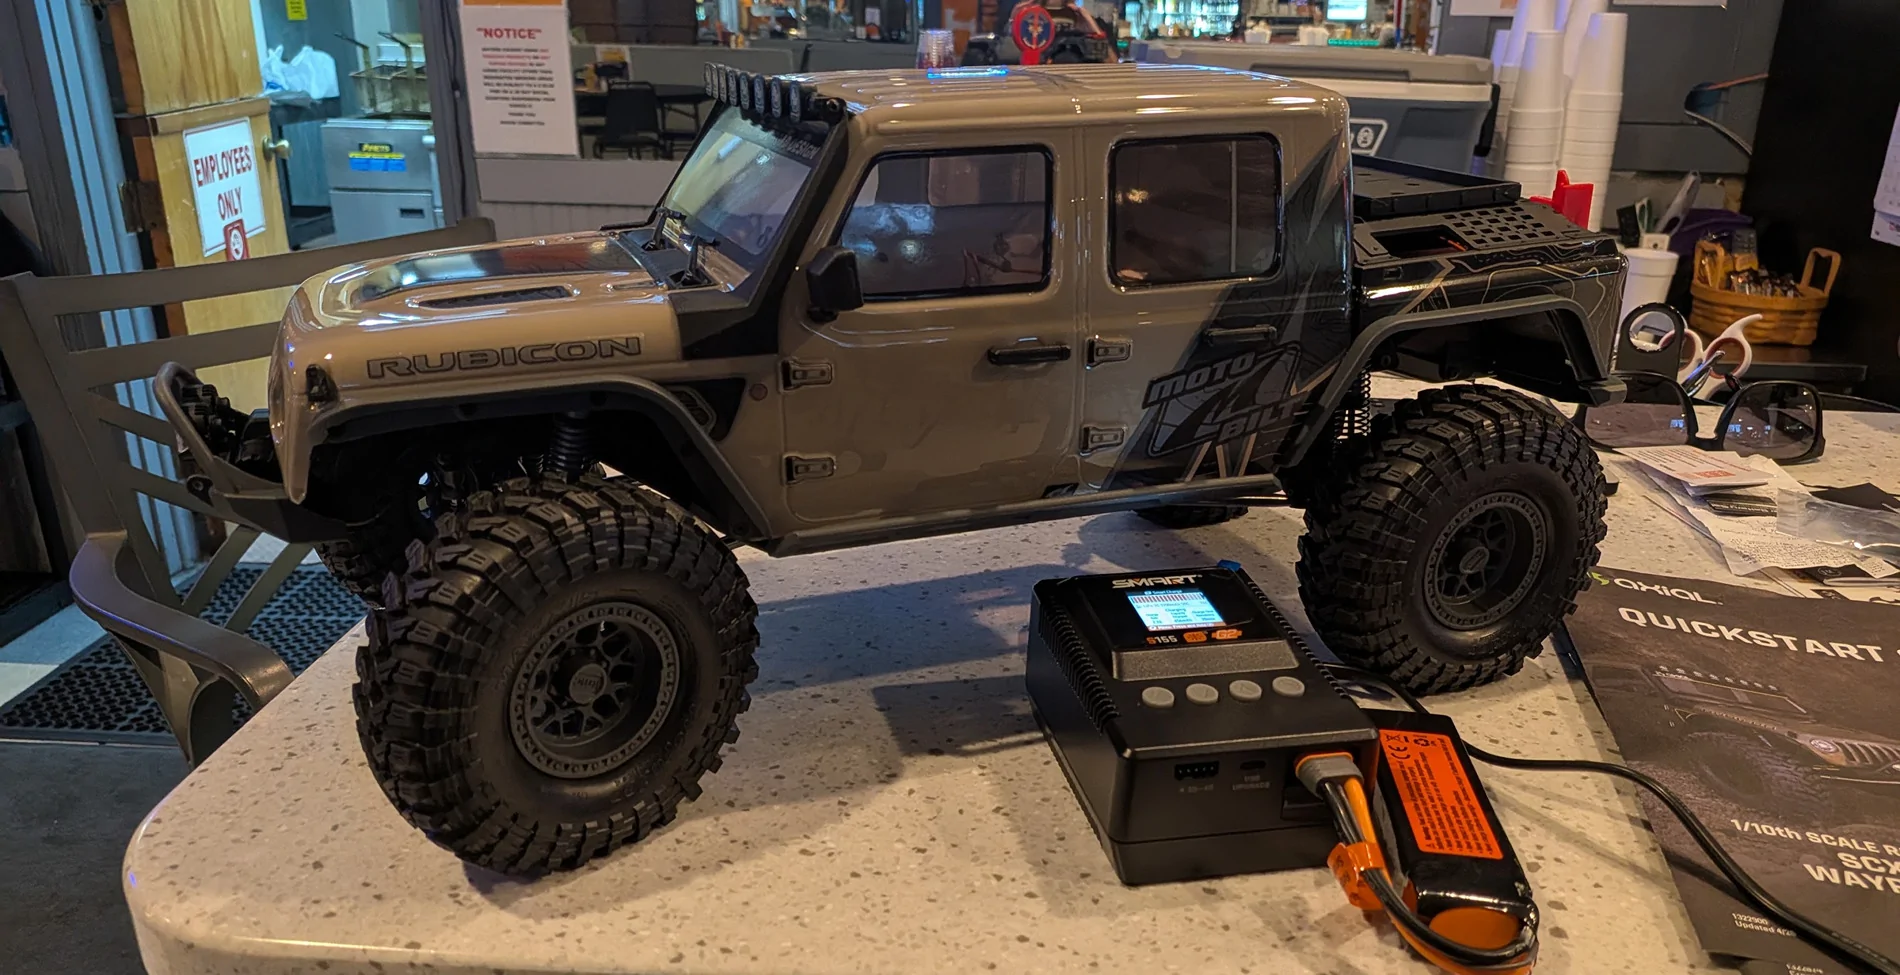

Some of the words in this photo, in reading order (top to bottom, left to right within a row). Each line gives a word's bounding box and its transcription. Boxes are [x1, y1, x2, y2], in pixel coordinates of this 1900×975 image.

[193, 145, 253, 187] EMPLOYEES
[217, 186, 243, 221] ONLY
[366, 335, 642, 379] RUBICON
[1148, 351, 1257, 403] MOTO
[1112, 574, 1198, 589] SMART
[1618, 607, 1884, 663] QUICKSTART
[1730, 819, 1802, 841] 1/10th
[1805, 831, 1881, 854] SCALE
